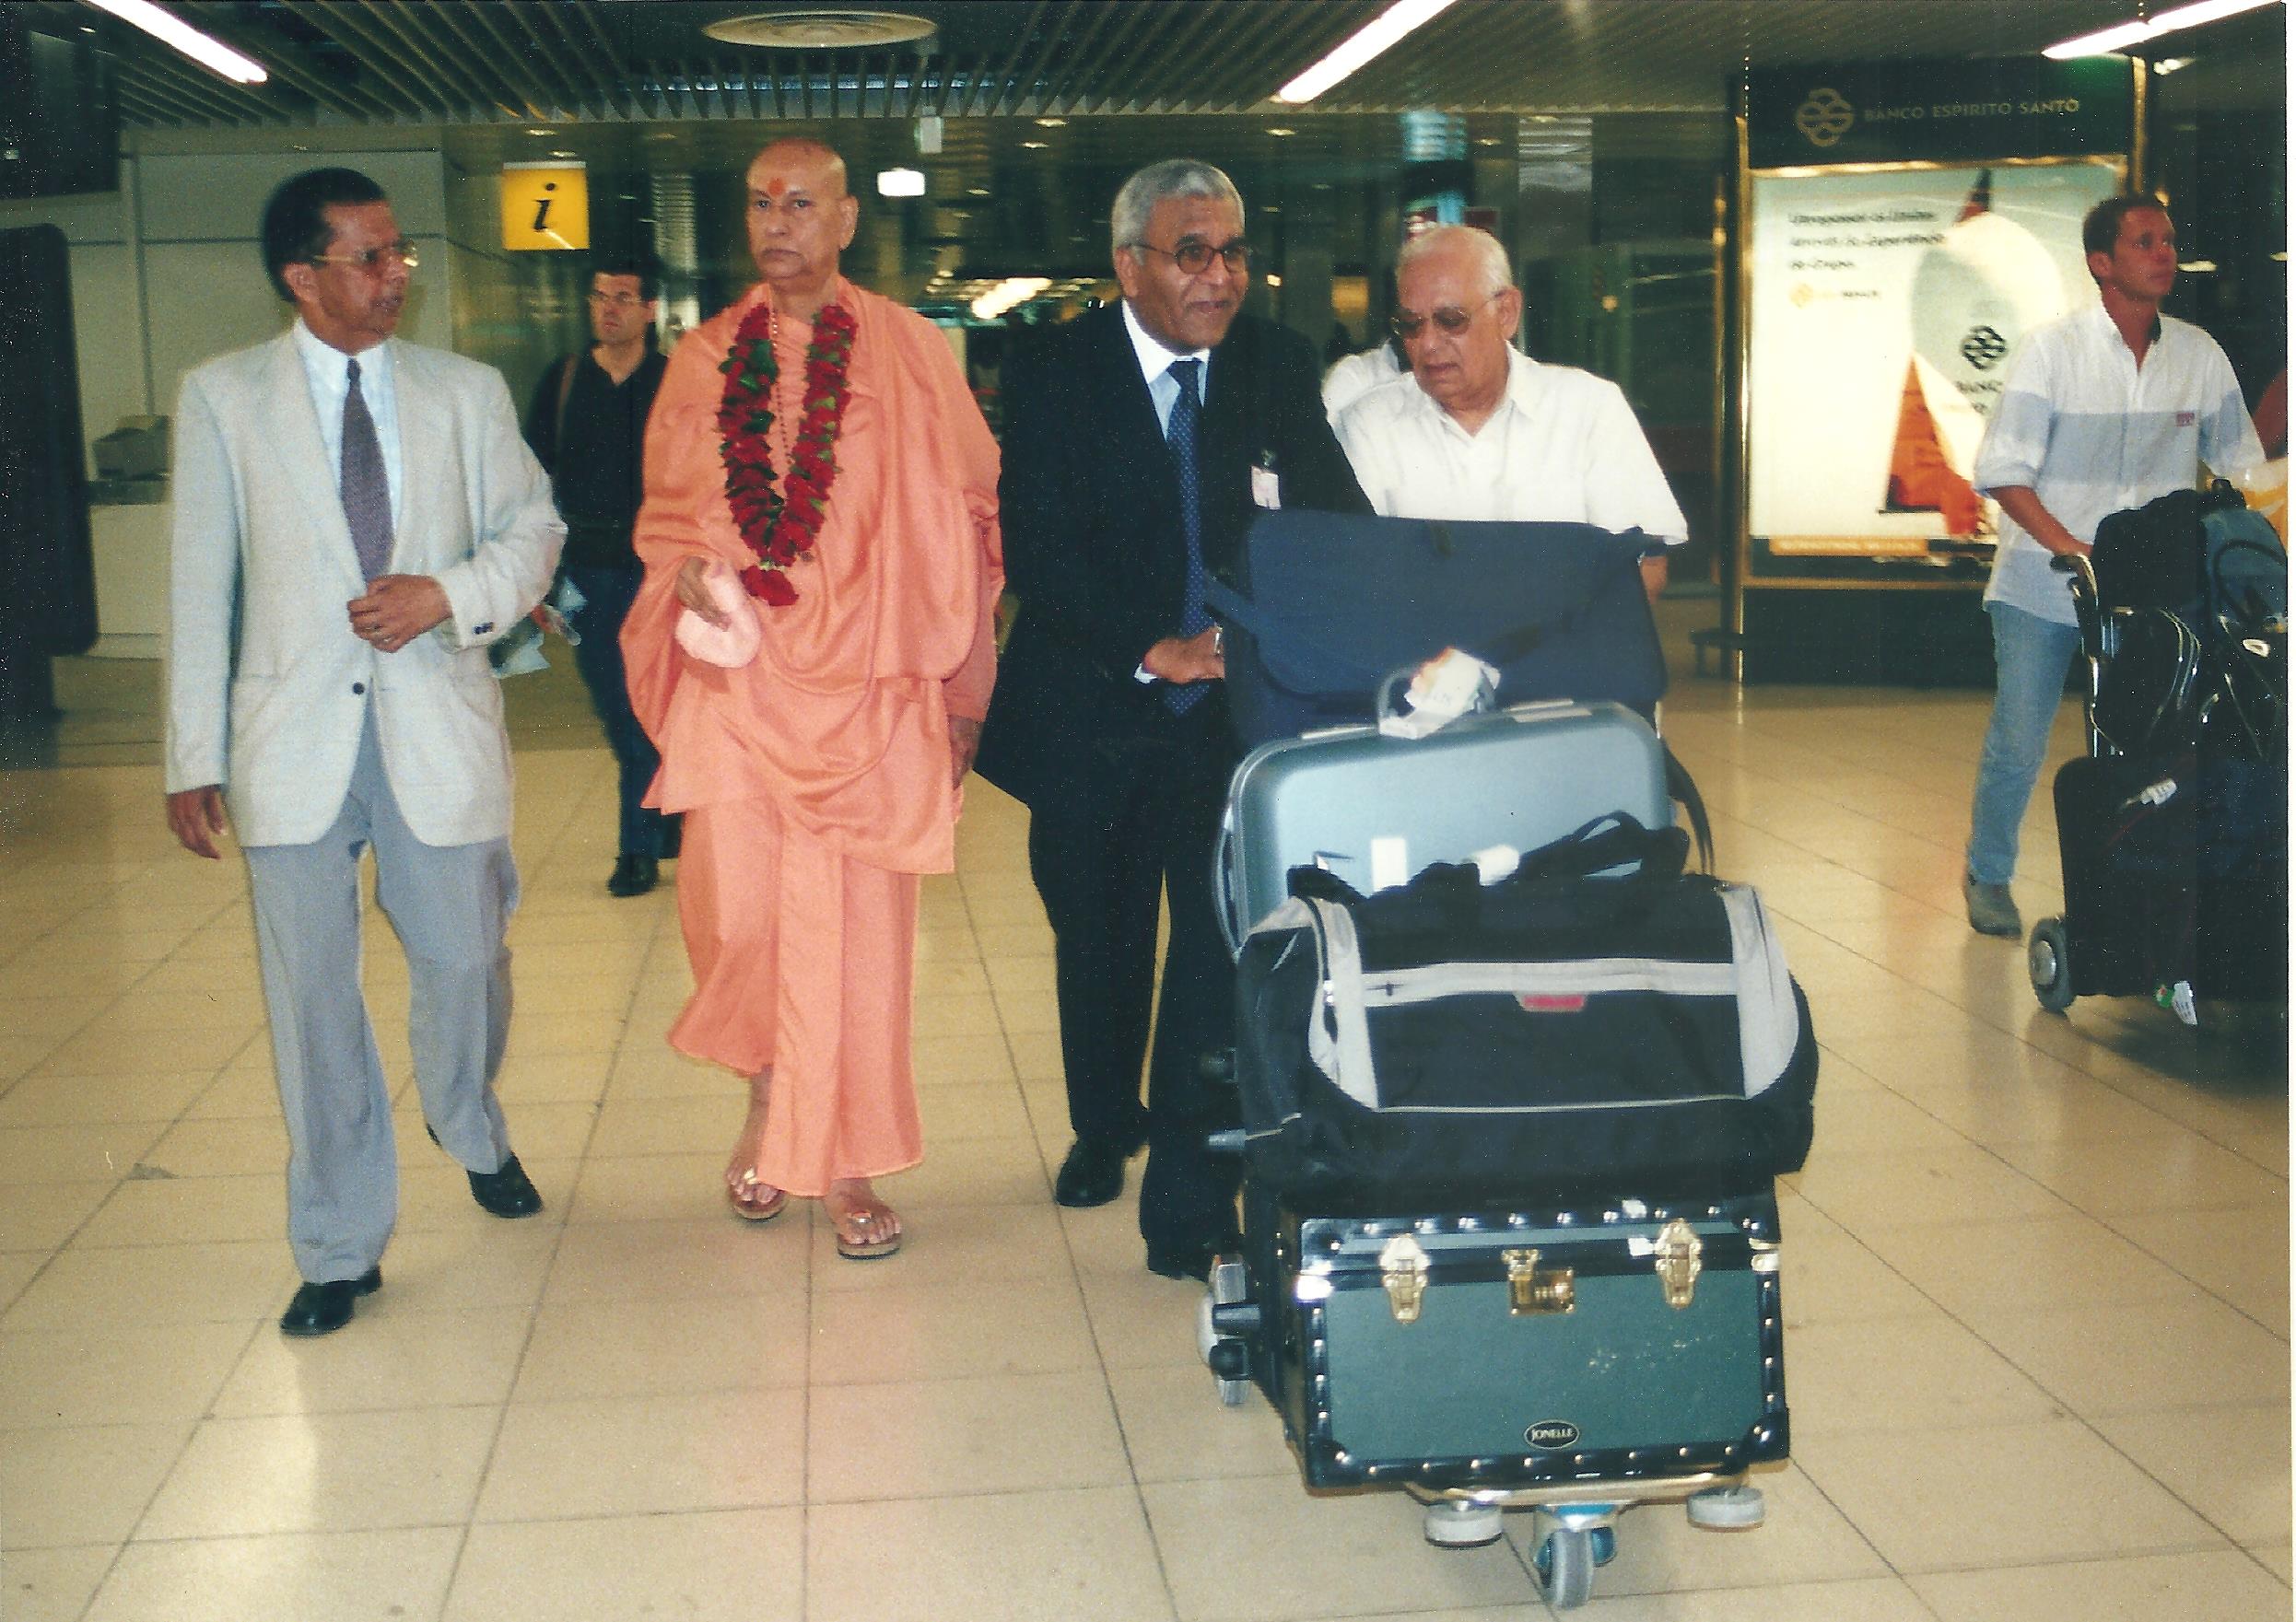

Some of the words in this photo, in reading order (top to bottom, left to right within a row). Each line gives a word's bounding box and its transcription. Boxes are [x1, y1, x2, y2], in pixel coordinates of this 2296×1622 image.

[1864, 107, 1925, 121] BANCO
[2019, 97, 2079, 115] SANTO
[532, 182, 556, 232] i
